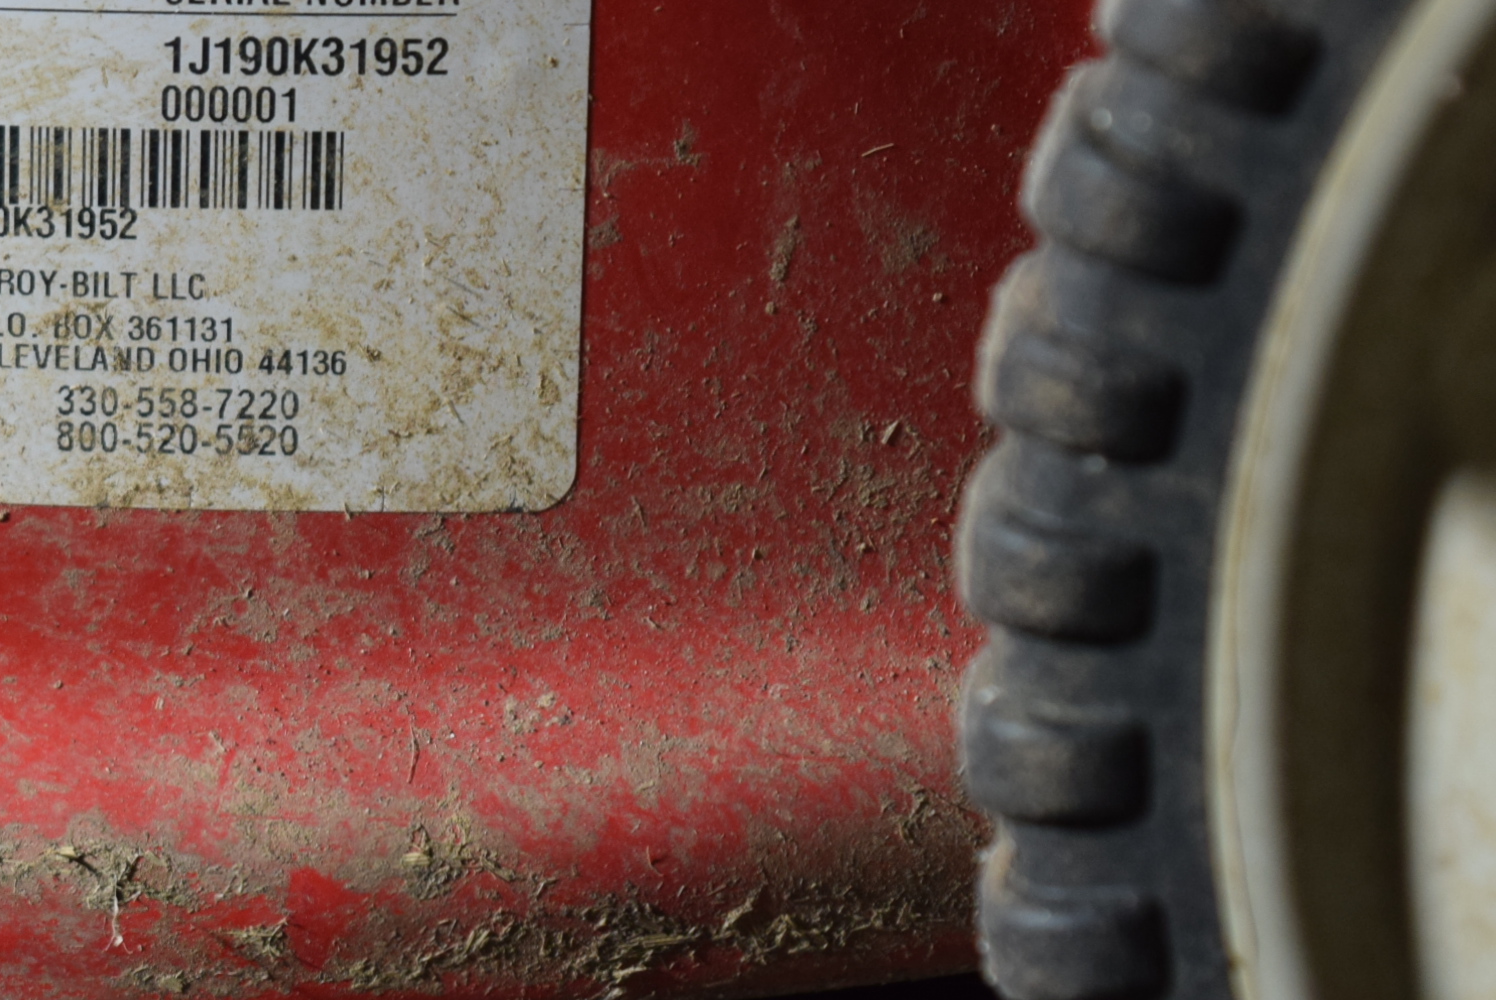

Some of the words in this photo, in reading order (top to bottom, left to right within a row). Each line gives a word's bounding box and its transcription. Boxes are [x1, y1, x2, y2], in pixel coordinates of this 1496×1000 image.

[164, 36, 449, 77] 1J190K31952
[161, 85, 297, 123] 000001
[152, 273, 206, 301] LLC
[54, 313, 115, 341] BOX
[128, 315, 233, 343] 361131
[169, 347, 244, 375] OHIO
[258, 349, 348, 376] 44136
[56, 384, 300, 421] 330-558-7220
[56, 422, 299, 456] 800-520-5520
